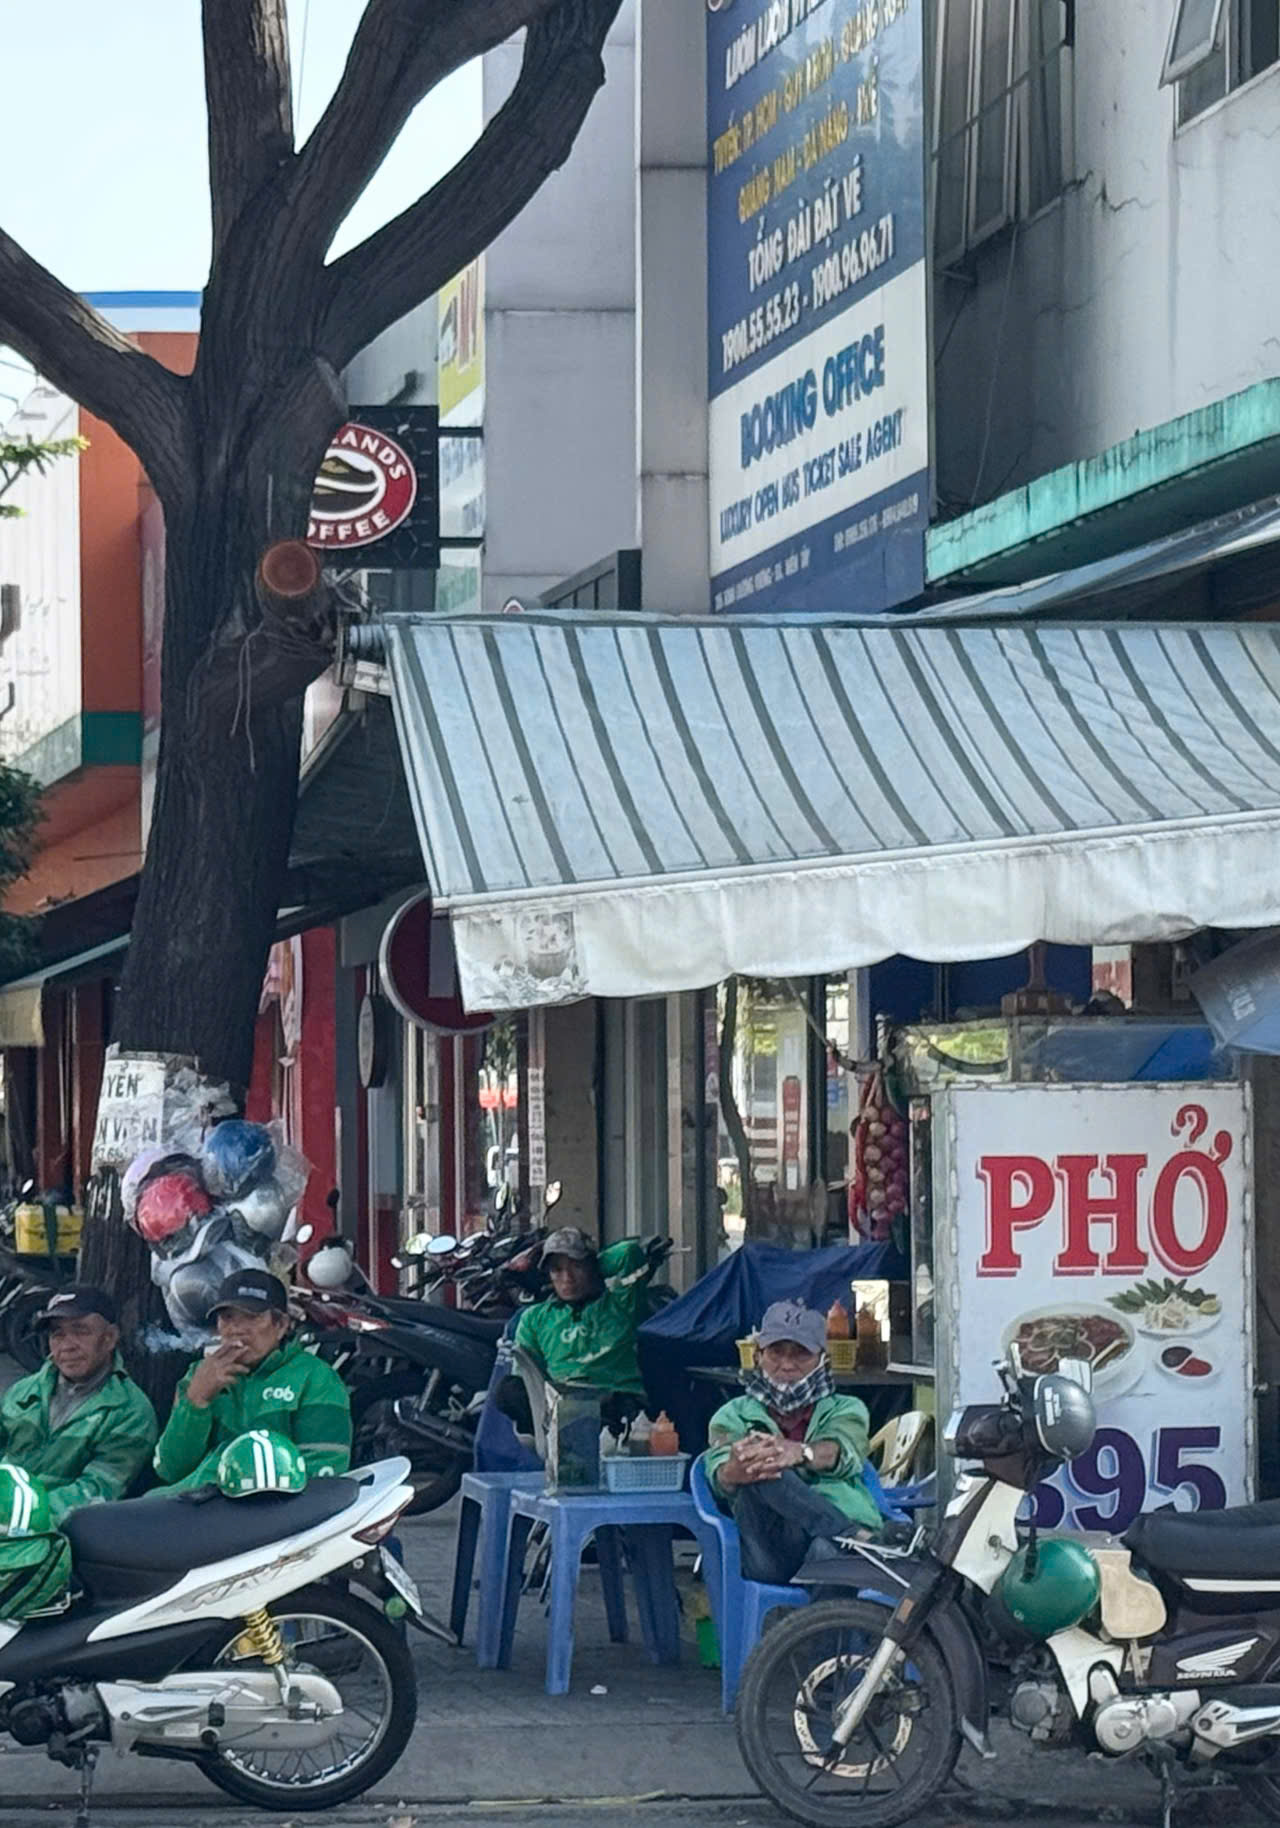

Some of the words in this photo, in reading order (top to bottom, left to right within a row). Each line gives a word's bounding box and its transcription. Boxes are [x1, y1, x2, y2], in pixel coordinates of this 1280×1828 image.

[749, 216, 784, 293] TỔNG
[788, 198, 812, 264] ĐÀI
[814, 177, 840, 248] ĐẶT
[843, 153, 863, 220] VÉ
[332, 430, 408, 481] ANDS
[740, 368, 818, 470] BOOKING
[822, 324, 886, 418] OFFICE
[754, 480, 779, 524] OPEN
[803, 447, 836, 499] TICKET
[838, 432, 862, 478] SALE
[865, 407, 904, 465] AGENT
[975, 1103, 1233, 1278] PHỞ
